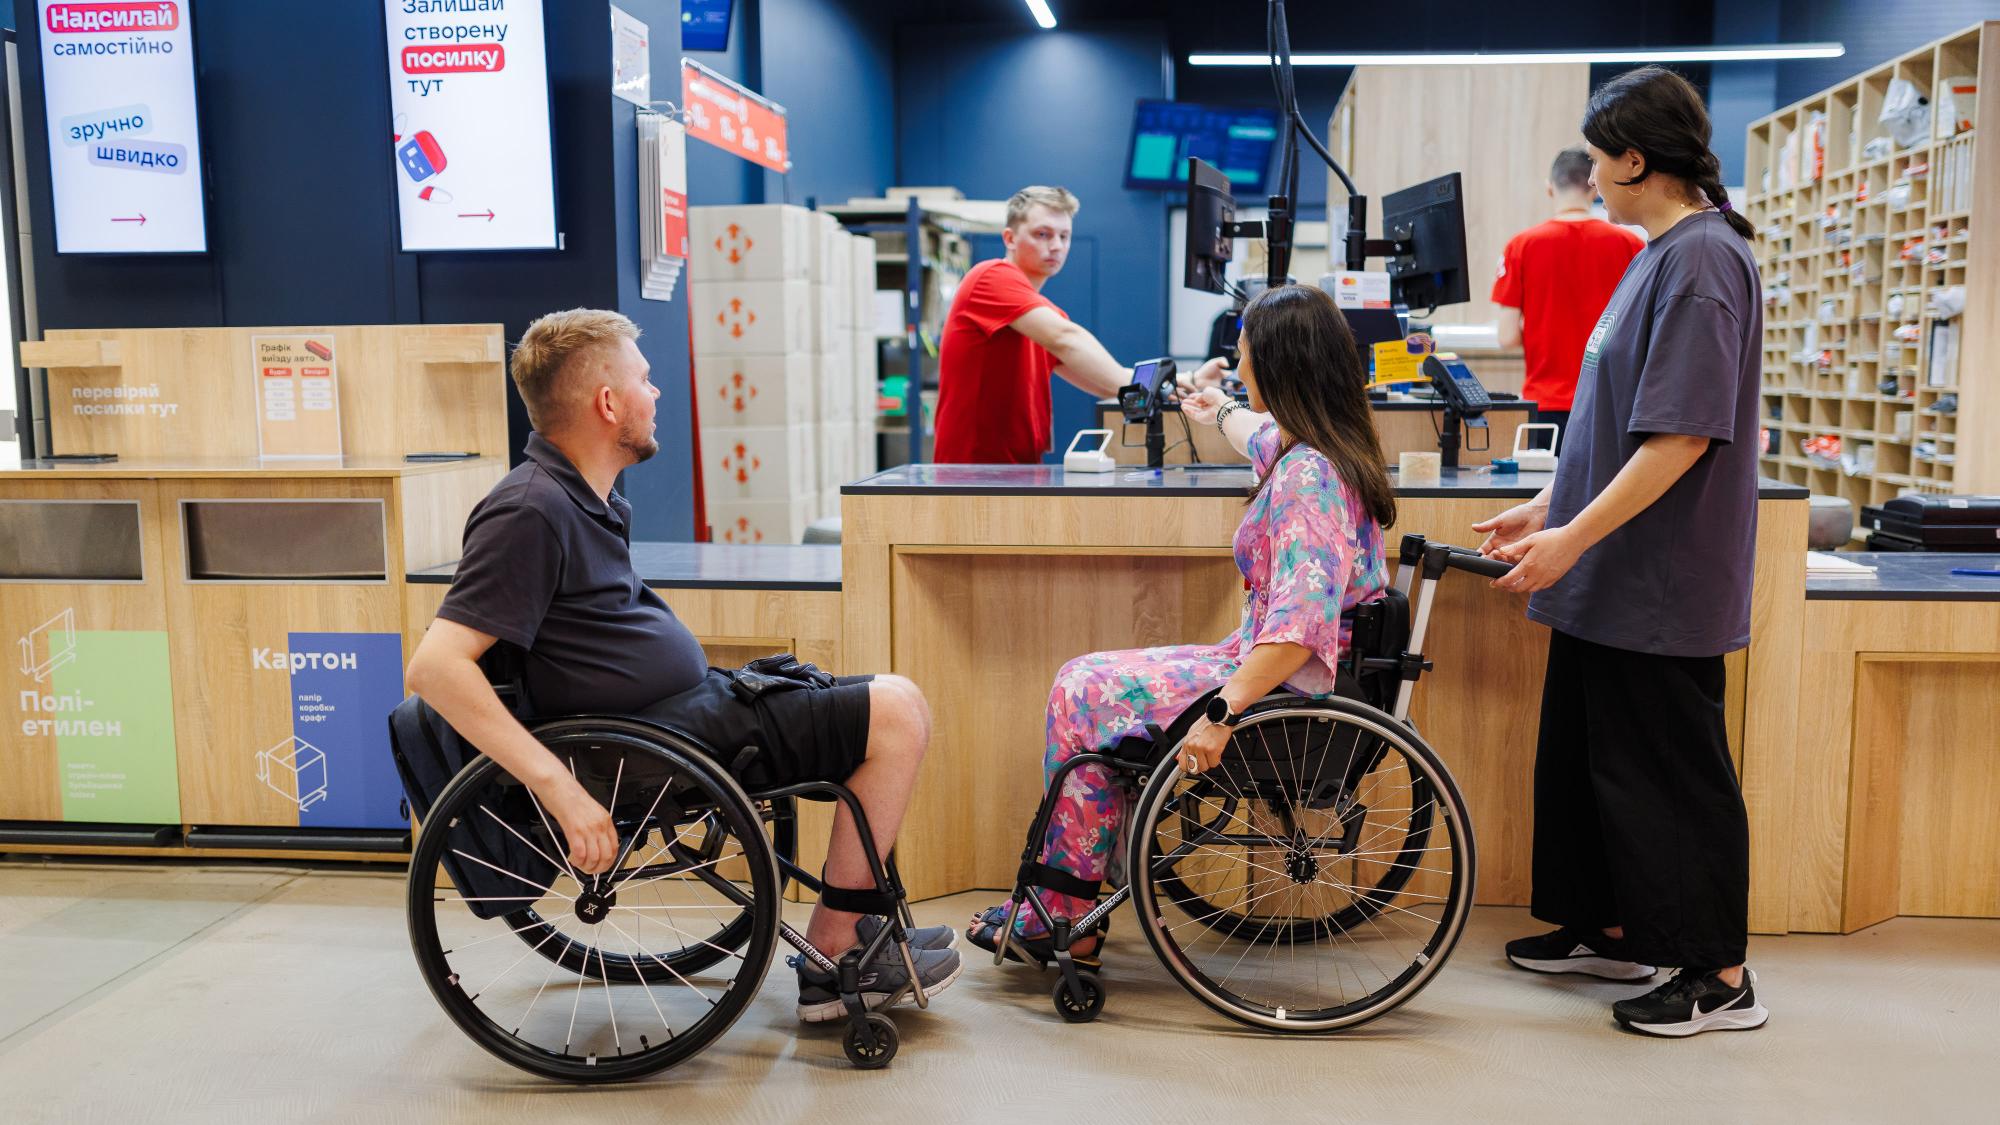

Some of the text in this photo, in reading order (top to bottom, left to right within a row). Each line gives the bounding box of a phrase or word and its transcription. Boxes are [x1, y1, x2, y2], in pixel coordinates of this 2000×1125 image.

[50, 4, 173, 31] Надсилай
[404, 24, 508, 43] створену
[53, 37, 173, 56] самостійно
[405, 50, 499, 70] посилку
[407, 79, 444, 97] тут
[70, 115, 144, 141] зручно
[96, 146, 179, 168] швидко
[72, 383, 160, 401] перевіряй
[73, 403, 178, 417] посилки тут
[252, 647, 357, 675] Картон
[20, 689, 95, 713] Полі-
[298, 692, 322, 703] папір
[299, 703, 335, 712] коробки
[22, 719, 122, 737] етилен
[300, 714, 326, 723] крафт
[783, 929, 834, 971] panthera
